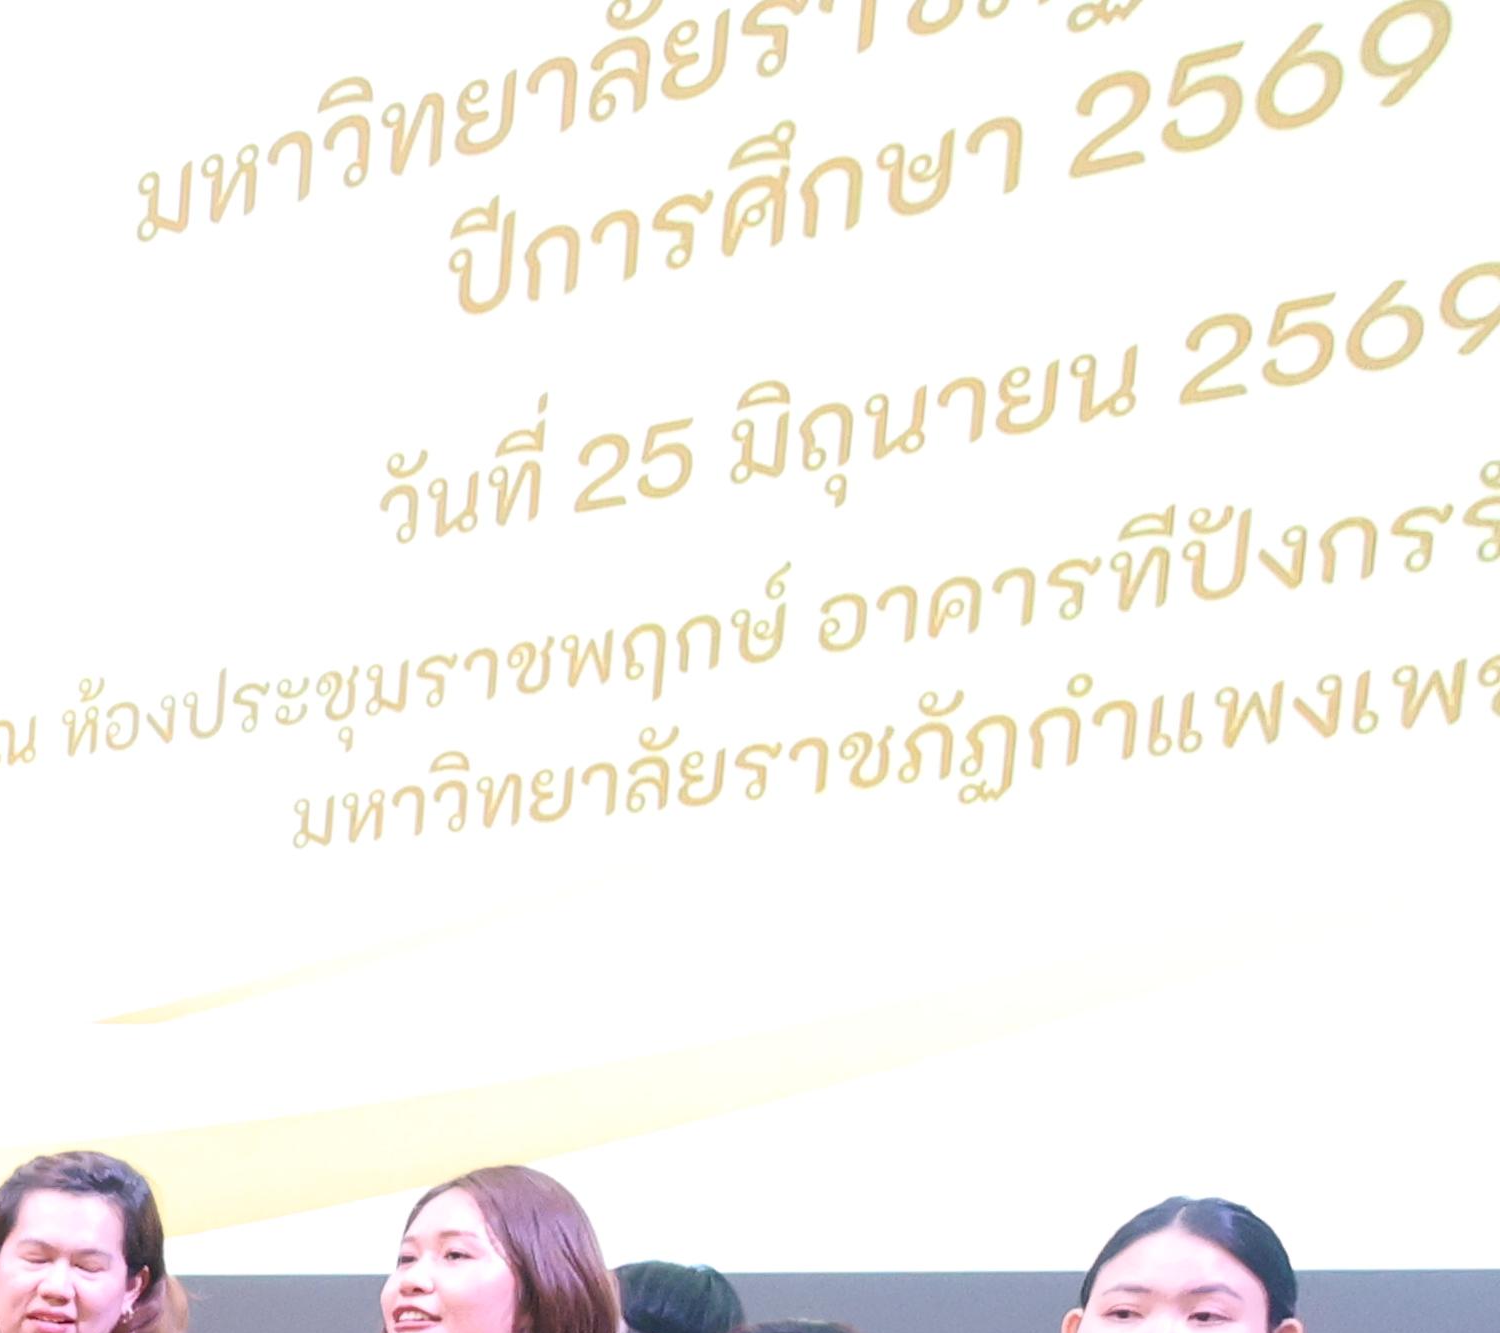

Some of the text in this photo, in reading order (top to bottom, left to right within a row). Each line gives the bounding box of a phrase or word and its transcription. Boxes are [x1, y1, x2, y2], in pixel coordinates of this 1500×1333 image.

[448, 0, 1454, 316] ปีการศึกษา 2569
[379, 260, 1500, 545] วันที่ 25 มิถุนายน 2569
[61, 560, 793, 759] ห้องประชุมราชพฤกษ์
